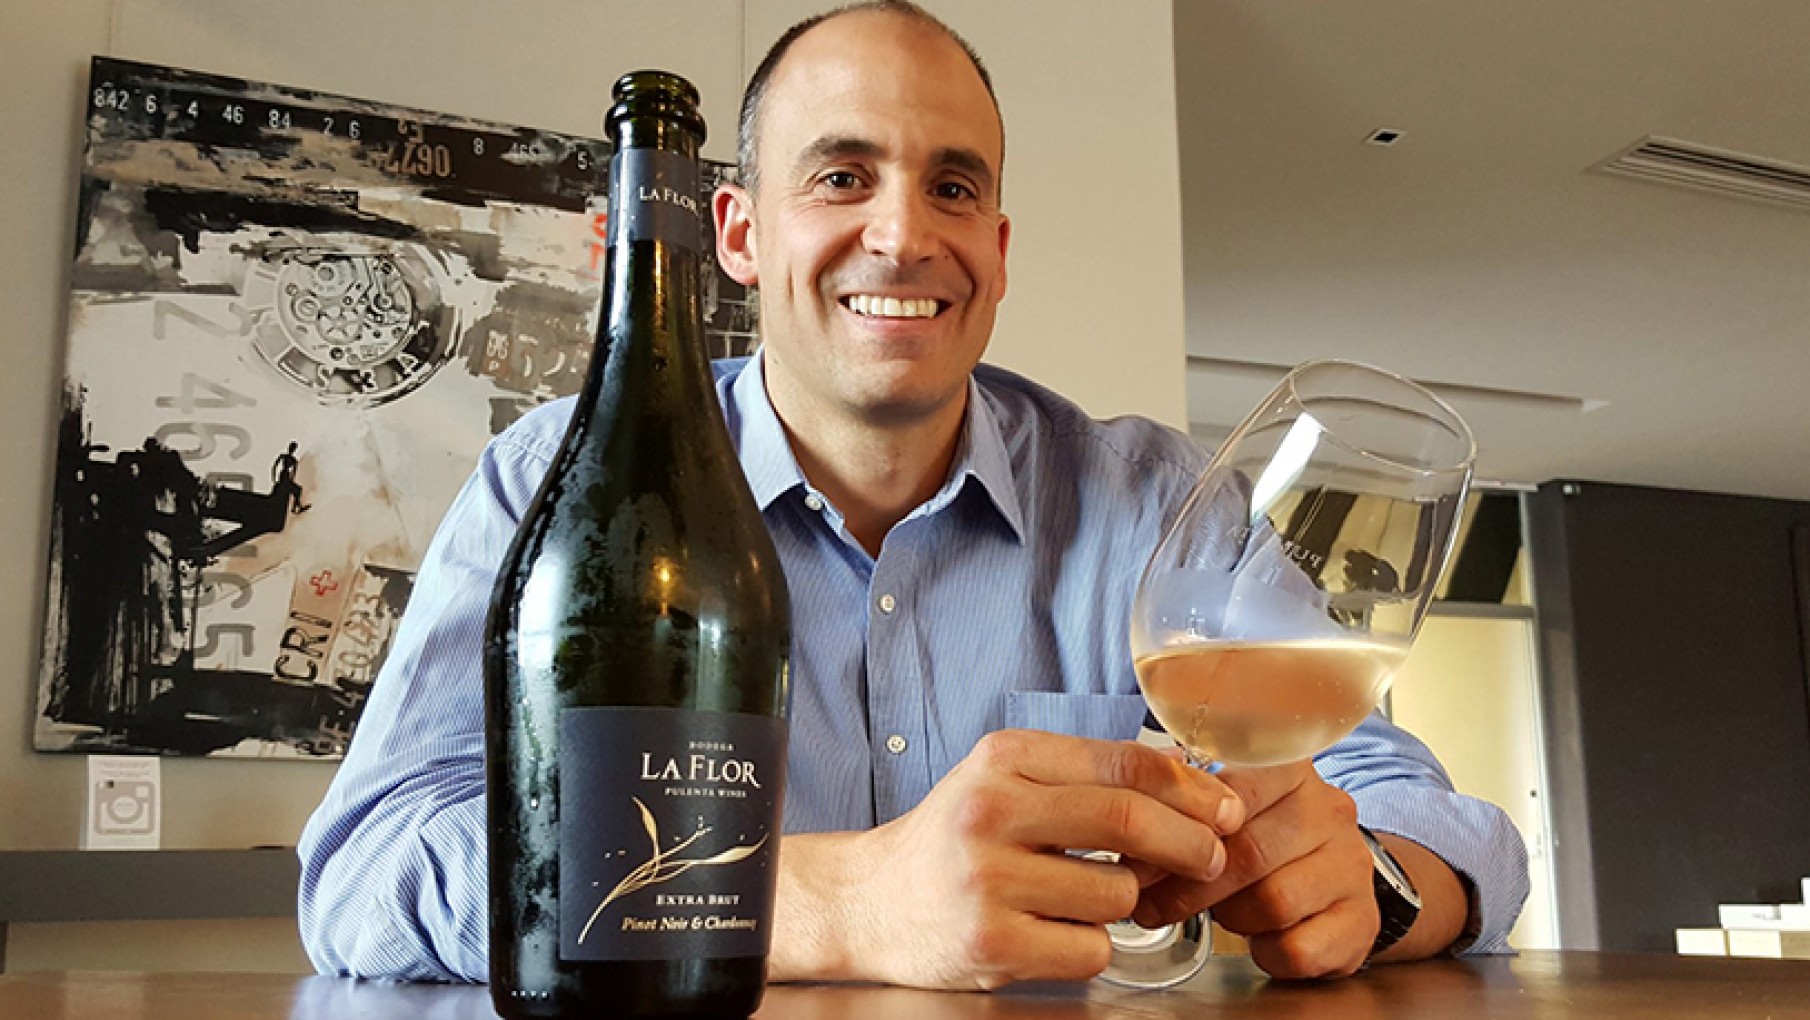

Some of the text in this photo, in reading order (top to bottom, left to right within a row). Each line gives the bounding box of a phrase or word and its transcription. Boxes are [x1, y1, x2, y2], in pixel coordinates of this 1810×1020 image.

[94, 86, 130, 111] 842
[146, 94, 157, 114] 6
[187, 101, 199, 118] 4
[221, 105, 245, 125] 46
[268, 108, 291, 129] 84
[349, 120, 360, 138] 6
[473, 138, 485, 155] 8
[639, 186, 699, 216] LA FLOR
[688, 741, 734, 751] BODEGA
[640, 752, 762, 788] LA FLOR
[664, 787, 747, 798] PULENTA WINES
[655, 894, 741, 905] EXTRA BRUT
[621, 917, 657, 931] Pinot
[659, 916, 690, 930] Noir
[692, 916, 702, 930] &
